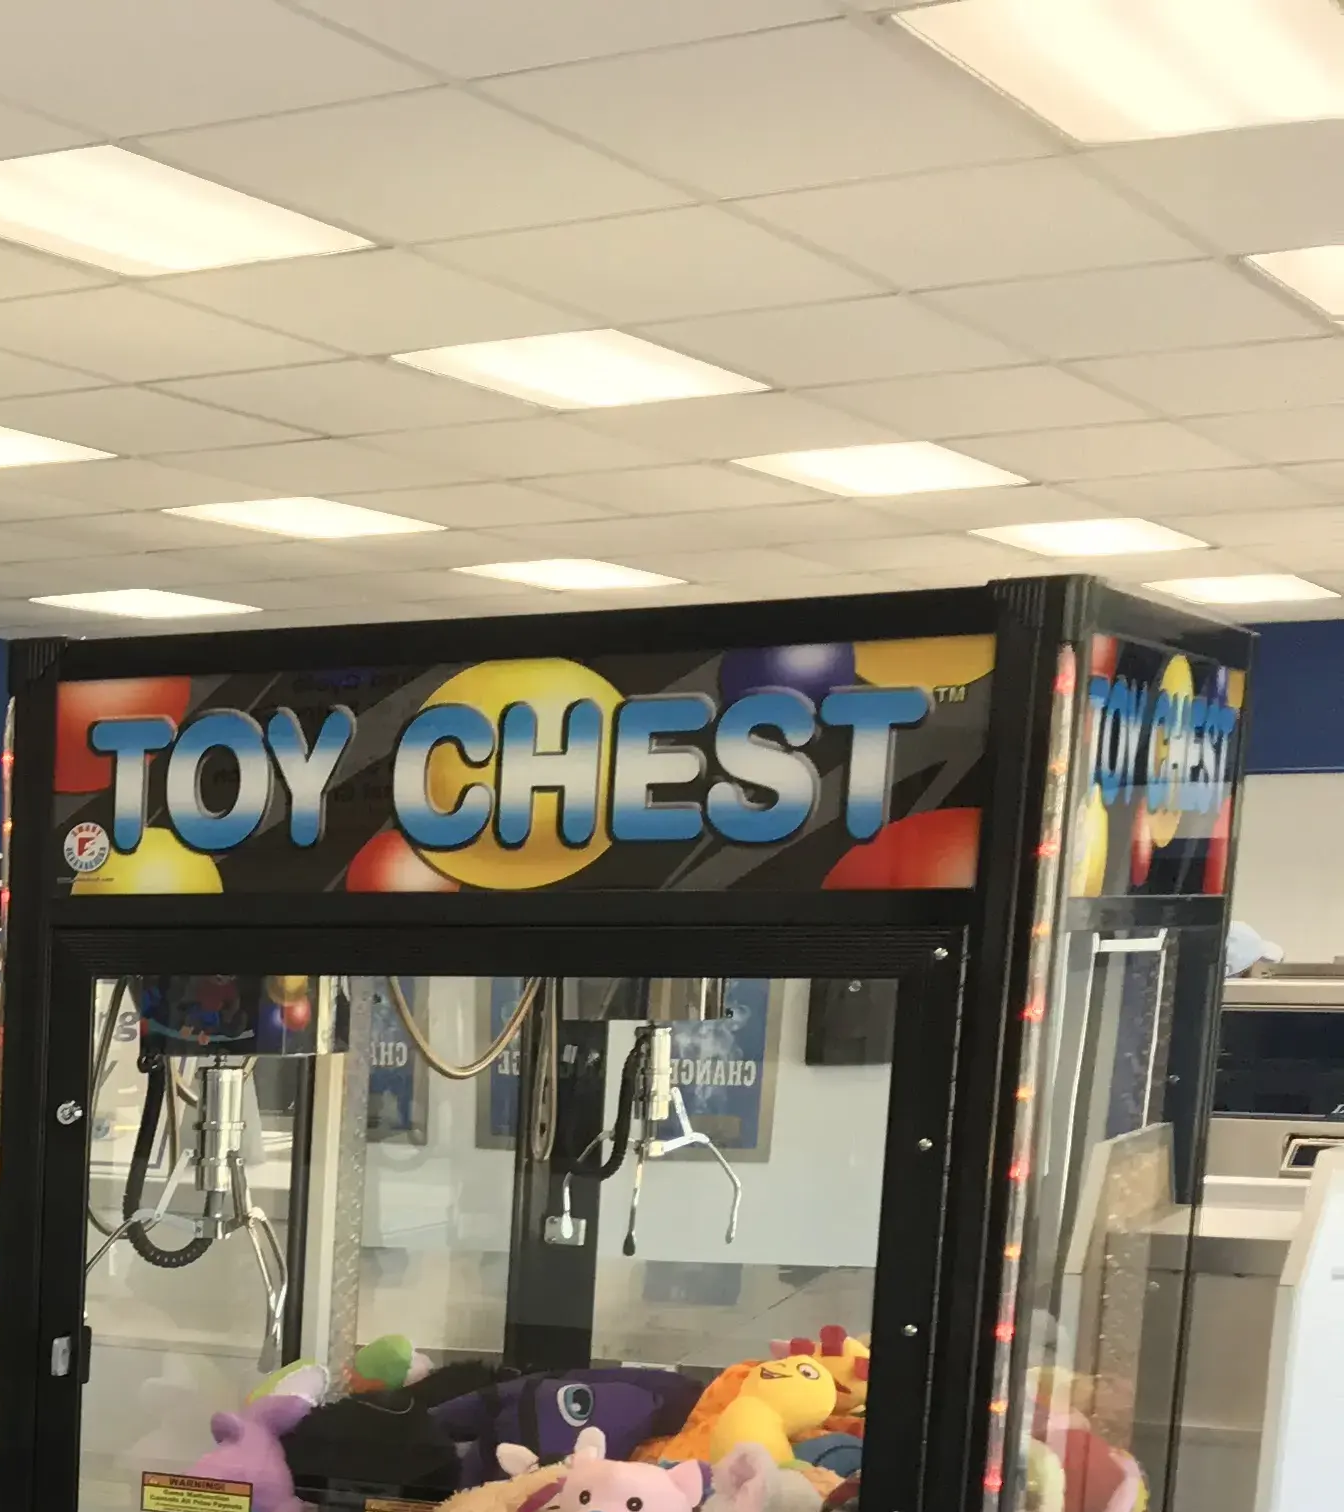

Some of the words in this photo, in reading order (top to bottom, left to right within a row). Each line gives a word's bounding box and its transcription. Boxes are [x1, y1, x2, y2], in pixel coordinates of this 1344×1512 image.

[88, 704, 360, 857] TOY
[393, 684, 934, 852] CHEST
[934, 685, 969, 703] TM
[1088, 674, 1149, 807] TOY
[1147, 690, 1239, 815] CHEST
[168, 1476, 227, 1491] WARNING!
